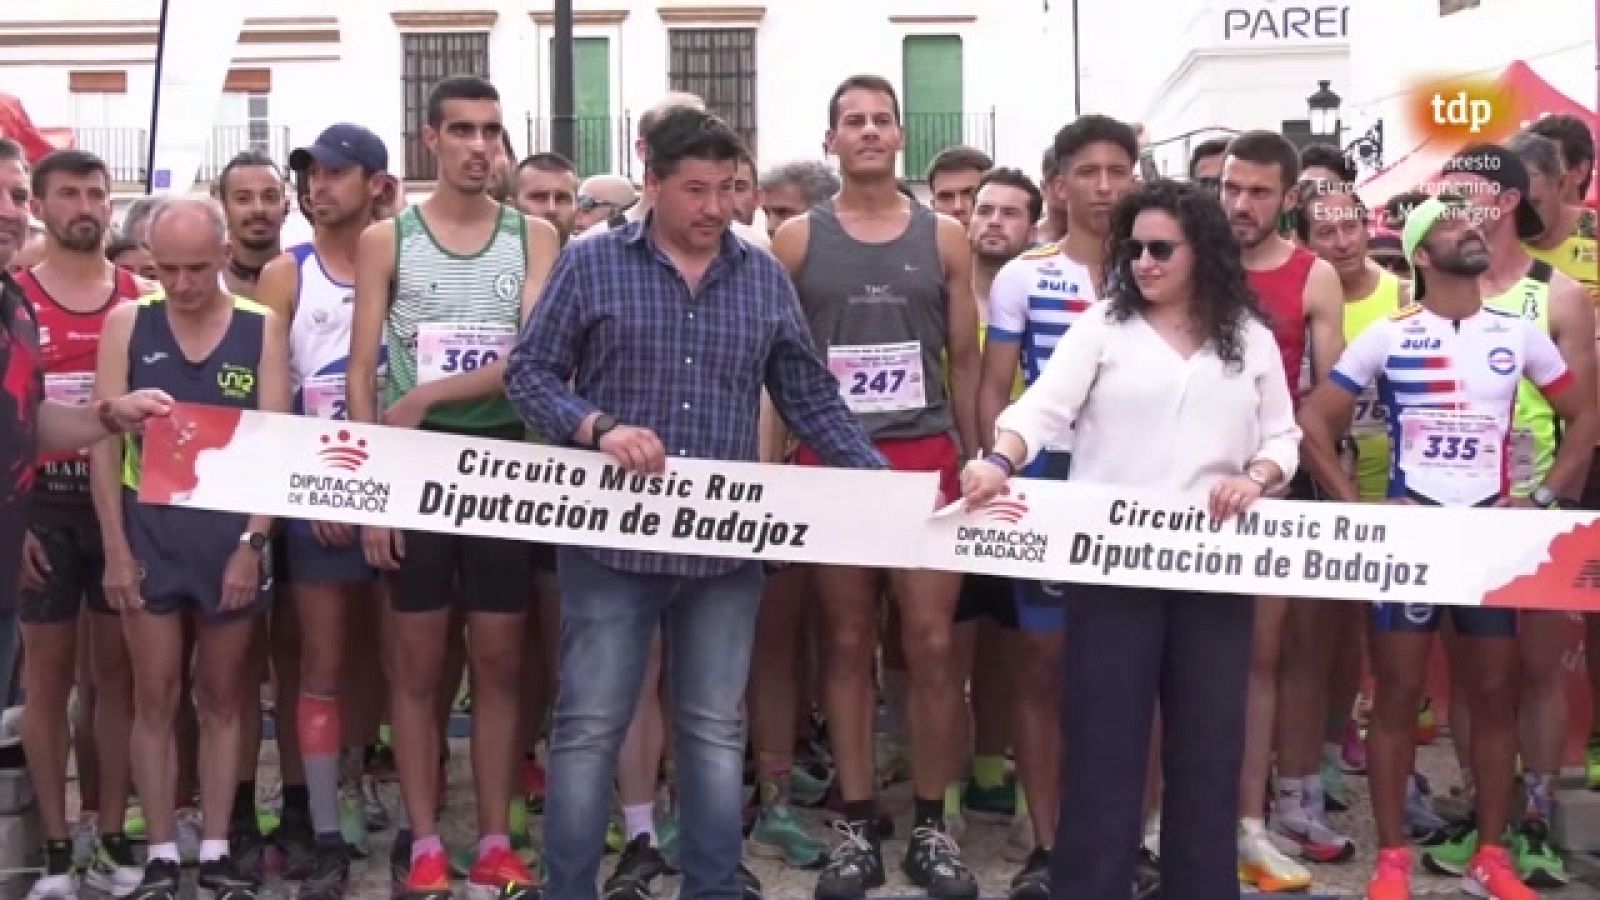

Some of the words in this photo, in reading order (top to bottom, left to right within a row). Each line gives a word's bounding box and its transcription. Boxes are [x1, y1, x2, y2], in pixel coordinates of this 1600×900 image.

[850, 370, 906, 395] 247
[1423, 435, 1480, 460] 335
[289, 473, 390, 497] DIPUTACIÓN
[457, 448, 587, 487] Circuito
[600, 464, 693, 498] Music
[705, 474, 764, 503] Run
[309, 492, 388, 512] BADAJOZ
[418, 480, 608, 527] Diputación
[619, 502, 661, 536] de
[672, 507, 809, 553] Badajoz
[1109, 499, 1223, 532] Circuito
[1236, 511, 1321, 541] Music
[1334, 516, 1387, 543] Run
[957, 525, 1048, 546] DIPUTACIÓN
[974, 543, 1046, 563] BADAJOZ
[1070, 533, 1243, 575] Diputación
[1254, 547, 1291, 577] de
[1304, 549, 1430, 592] Badajoz
